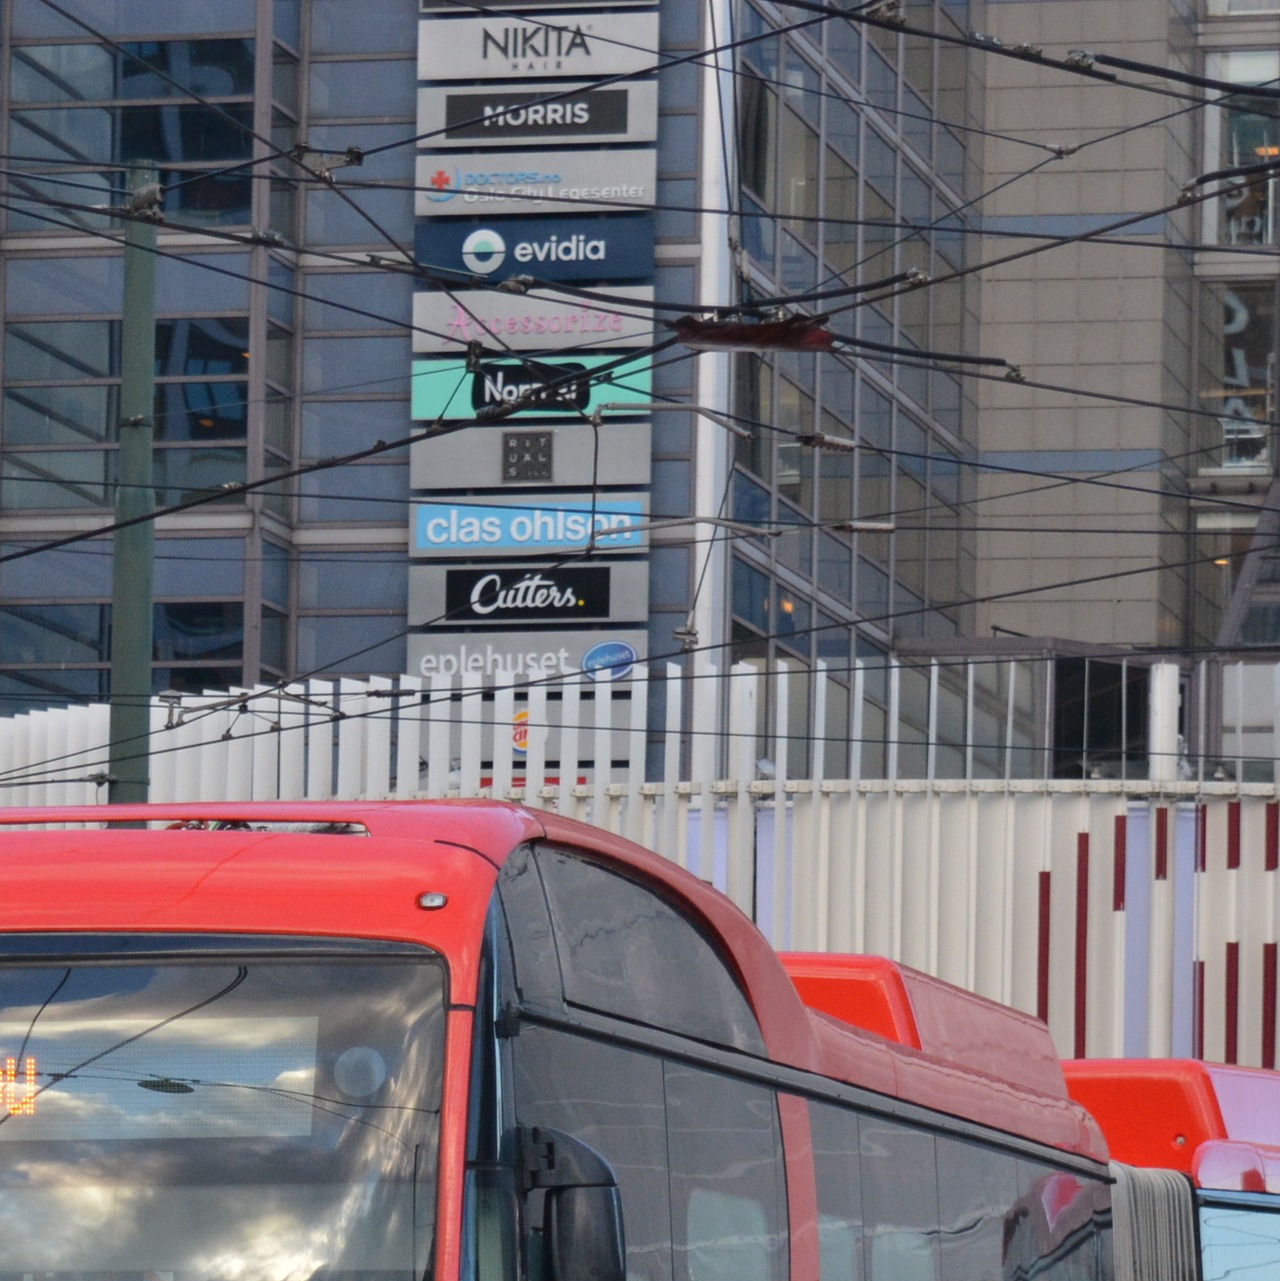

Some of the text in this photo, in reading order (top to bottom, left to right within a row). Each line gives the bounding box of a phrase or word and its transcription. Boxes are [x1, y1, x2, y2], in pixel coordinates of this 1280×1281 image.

[483, 25, 591, 59] NIKITA
[512, 61, 562, 70] HAIR
[483, 102, 589, 127] MORRIS
[514, 235, 606, 263] evidia
[442, 299, 624, 345] Accessorize
[426, 505, 633, 544] clas ohlson
[419, 645, 571, 681] eplehuset
